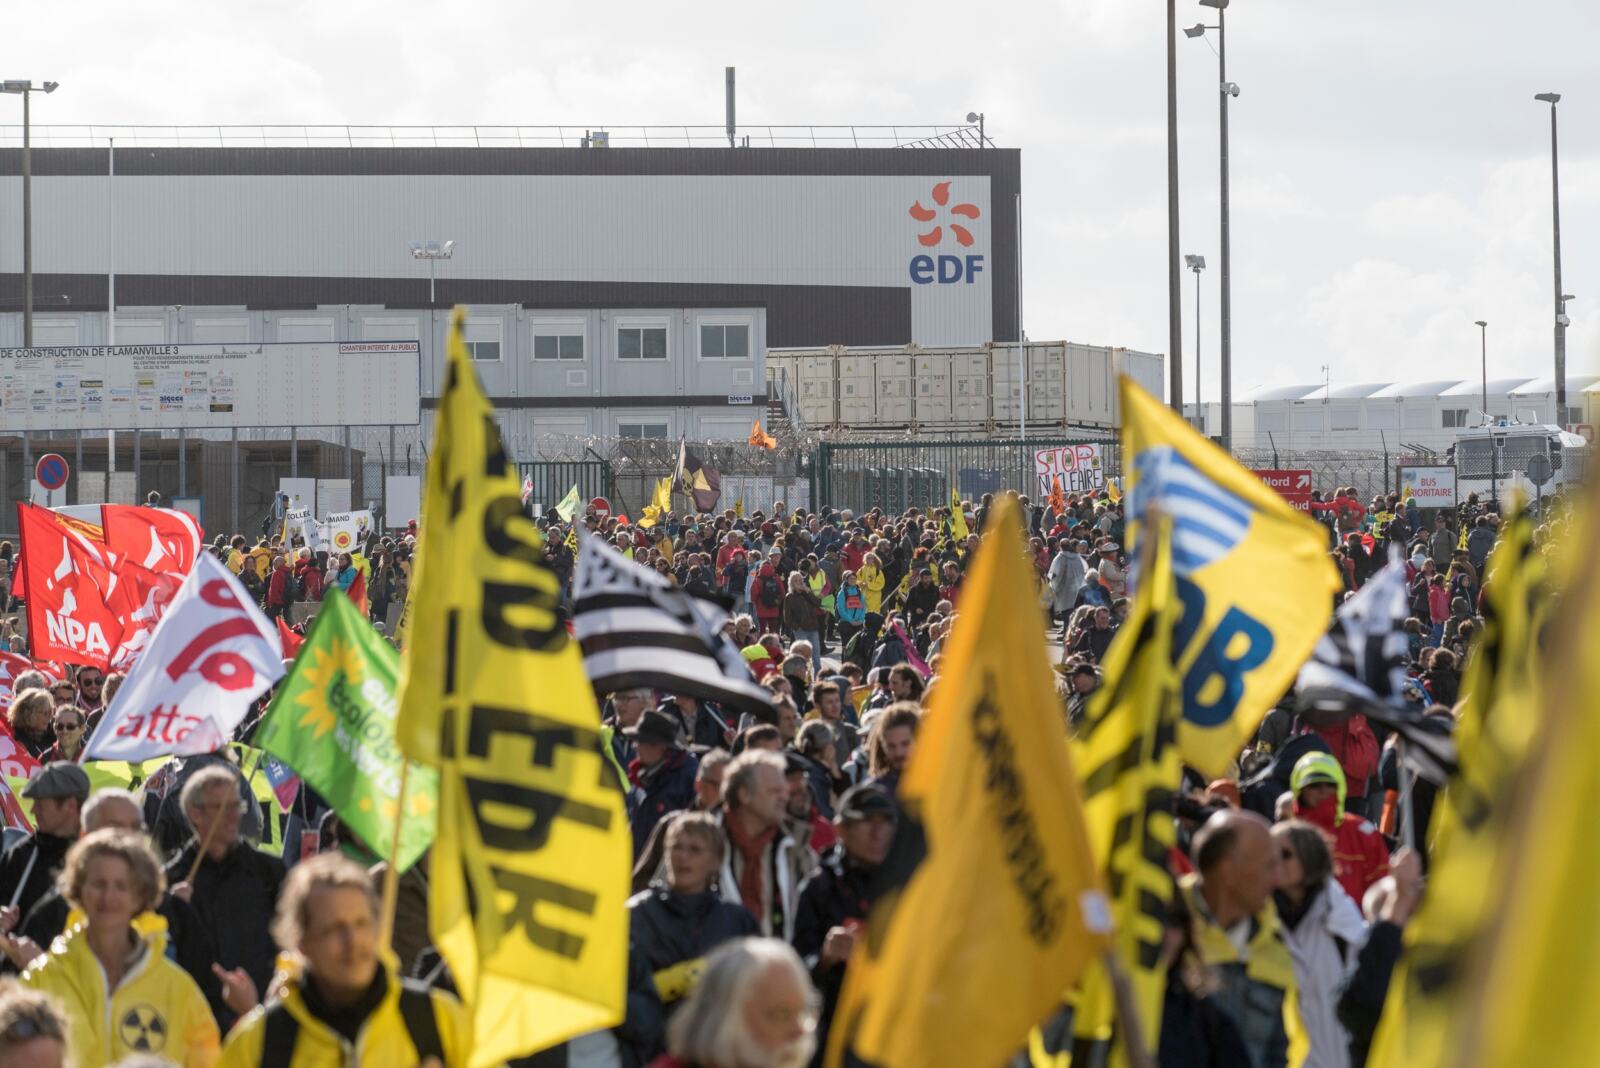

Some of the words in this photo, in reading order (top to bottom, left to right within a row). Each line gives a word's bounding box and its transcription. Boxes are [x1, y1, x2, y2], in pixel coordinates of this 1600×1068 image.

[1, 349, 14, 358] DE
[16, 348, 89, 358] CONSTRUCTION
[92, 347, 105, 356] DE
[107, 346, 171, 356] FLAMANVILLE
[173, 346, 179, 355] 3
[399, 343, 417, 351] PUBLIC
[1036, 445, 1094, 475] STOP
[1262, 476, 1290, 487] Nord
[1420, 477, 1437, 487] BUS
[1288, 500, 1309, 511] Sud
[46, 609, 110, 655] NPA
[116, 703, 203, 745] atta
